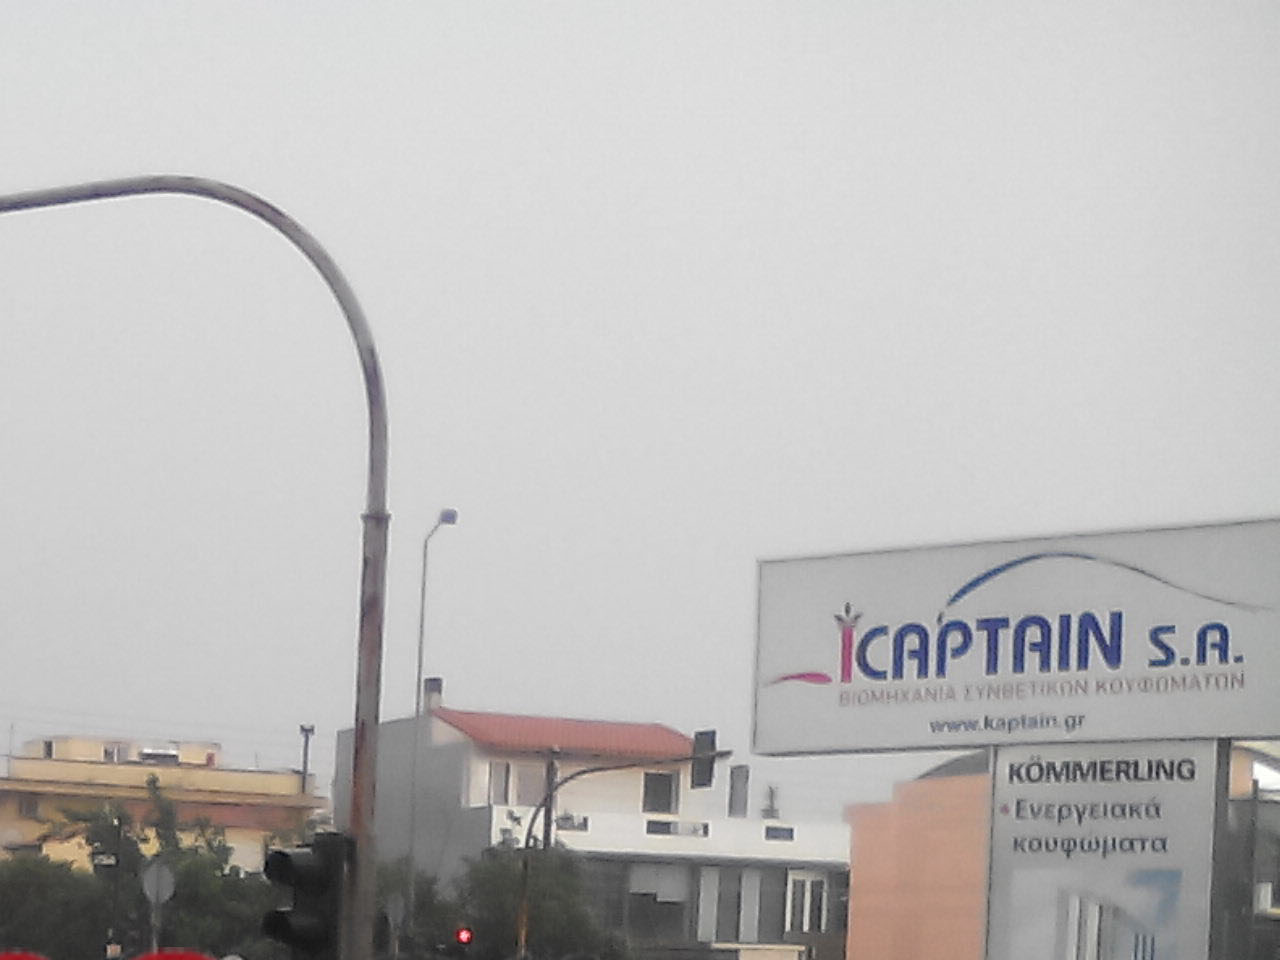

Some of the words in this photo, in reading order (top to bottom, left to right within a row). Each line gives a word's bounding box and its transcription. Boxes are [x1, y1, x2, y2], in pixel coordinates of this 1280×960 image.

[1148, 622, 1244, 668] S.A.
[929, 713, 1086, 733] www.kaptain.gr
[1008, 755, 1196, 783] KÖMMERLING
[1015, 796, 1162, 826] Ενεργειακά
